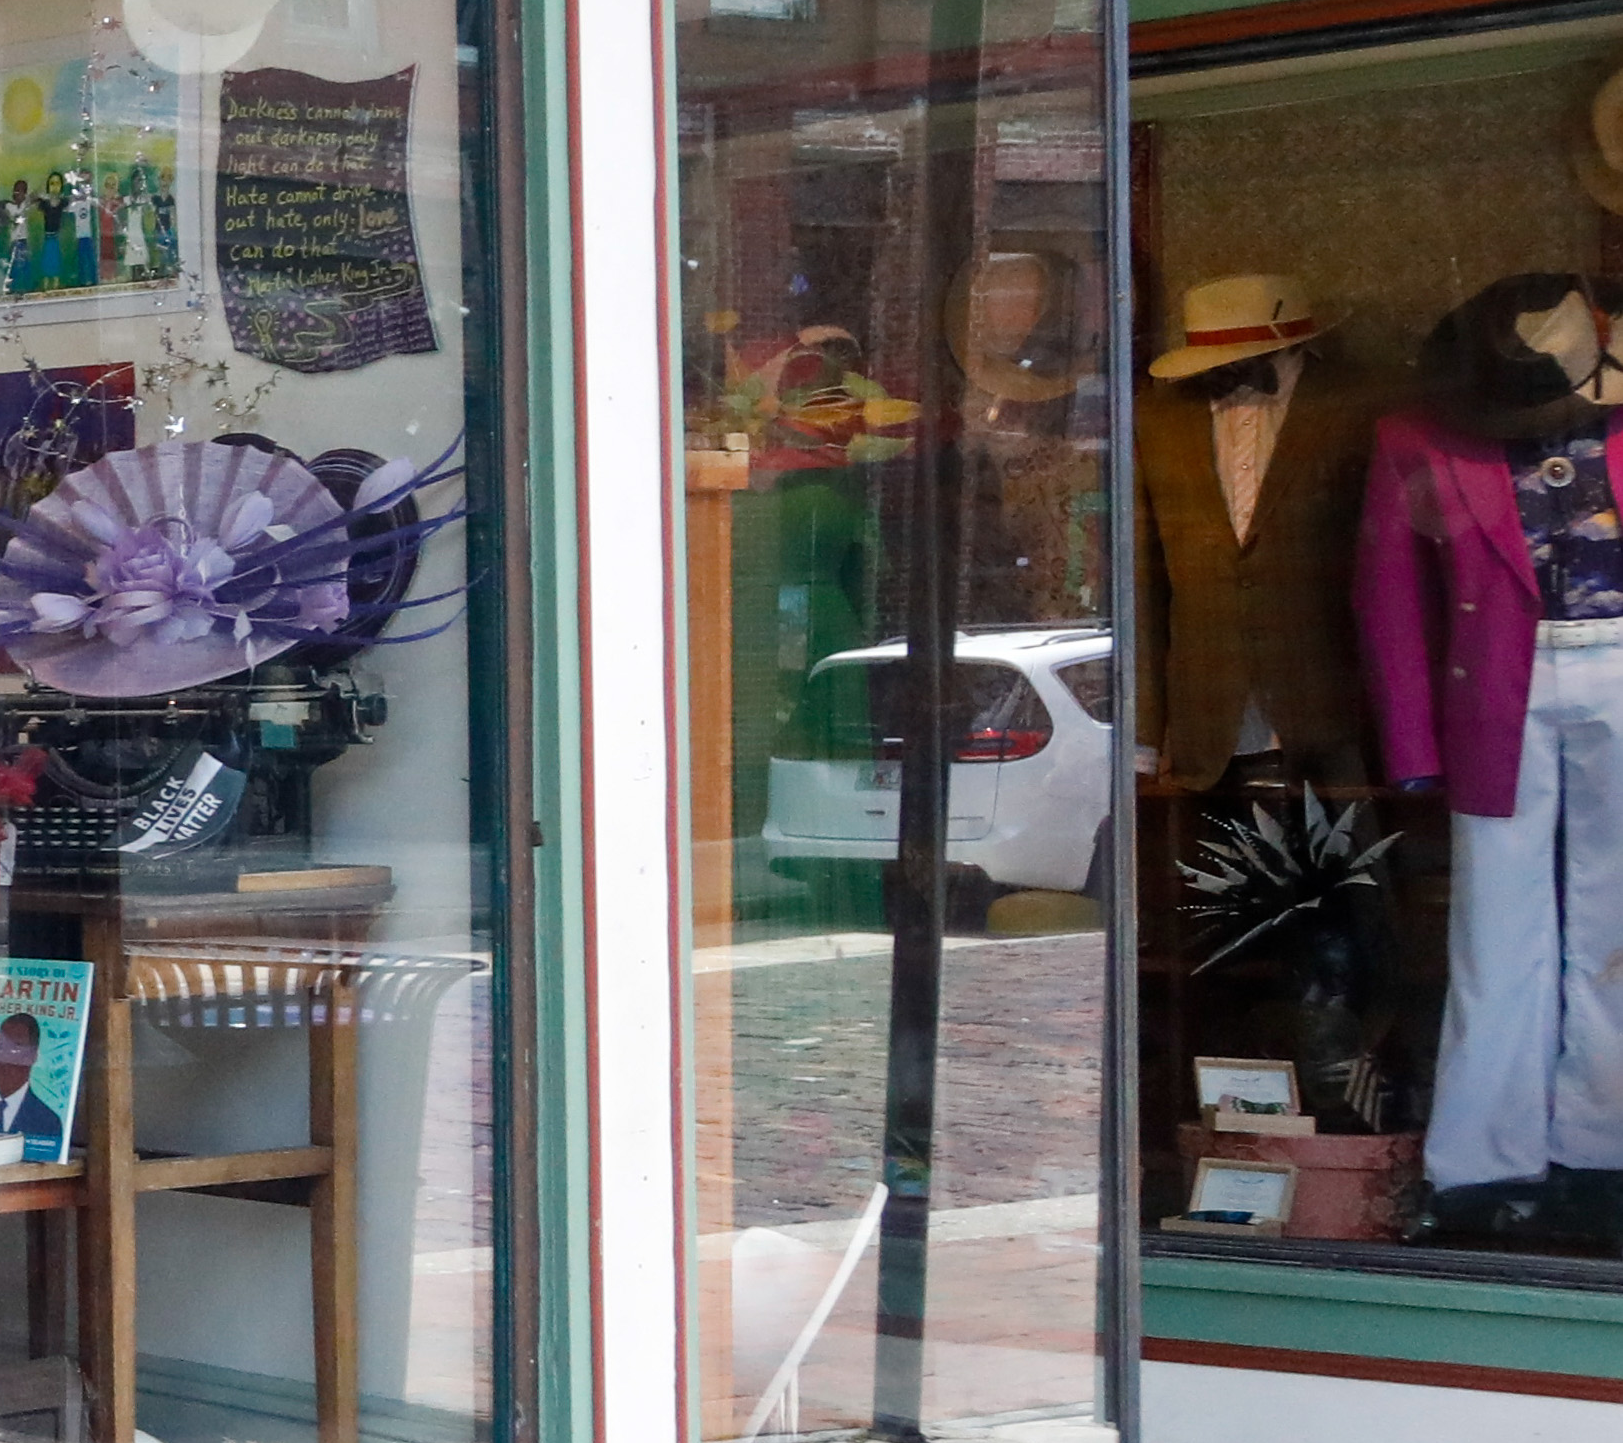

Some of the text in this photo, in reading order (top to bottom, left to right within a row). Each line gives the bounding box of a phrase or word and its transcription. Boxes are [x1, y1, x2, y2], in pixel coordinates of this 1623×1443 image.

[236, 126, 263, 146] out
[345, 128, 379, 151] only
[225, 154, 265, 179] light
[272, 161, 298, 173] can
[304, 153, 324, 173] do
[225, 186, 268, 207] Hate
[277, 183, 327, 206] cannot
[225, 212, 256, 232] out
[266, 208, 307, 233] hate,
[230, 244, 264, 262] can
[272, 236, 295, 259] do
[341, 260, 369, 289] King
[133, 776, 184, 830] BLACK
[155, 788, 196, 835] LIVES
[26, 1003, 80, 1021] KING JR.
